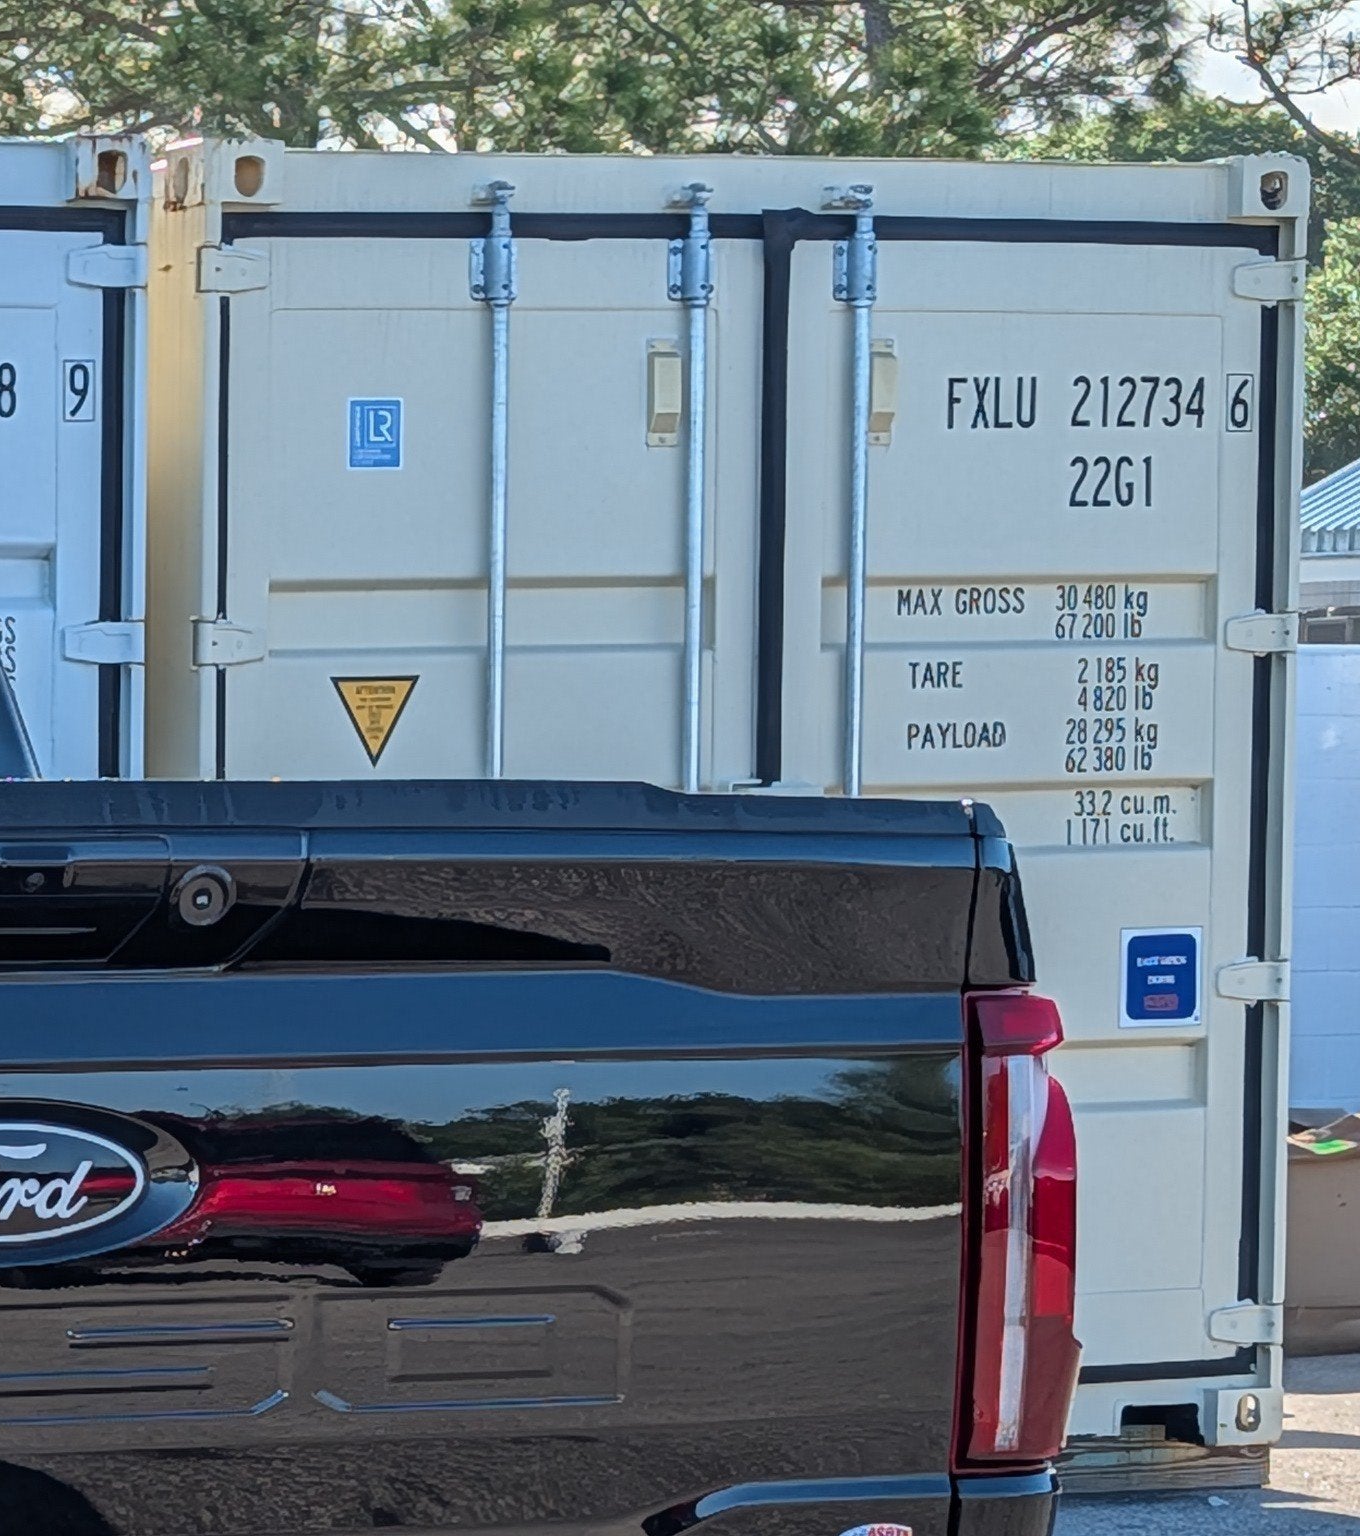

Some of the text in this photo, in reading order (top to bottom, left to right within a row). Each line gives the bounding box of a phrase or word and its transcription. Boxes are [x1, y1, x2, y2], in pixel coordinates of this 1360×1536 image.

[69, 364, 90, 417] 9
[947, 375, 1249, 429] FXLU 212734 6
[1069, 456, 1152, 507] 22G1
[897, 588, 943, 616] MAX
[955, 587, 1025, 614] GROSS
[1124, 585, 1148, 617] kg
[1124, 613, 1142, 638] lb
[908, 661, 964, 689] TARE
[1135, 656, 1159, 690] kg
[1135, 685, 1153, 710] lb
[907, 721, 1006, 749] PAYLOAD
[1134, 717, 1158, 750] kg
[1134, 746, 1152, 771] lb
[1120, 793, 1177, 815] cu.m.
[1120, 816, 1175, 844] cu.ft.
